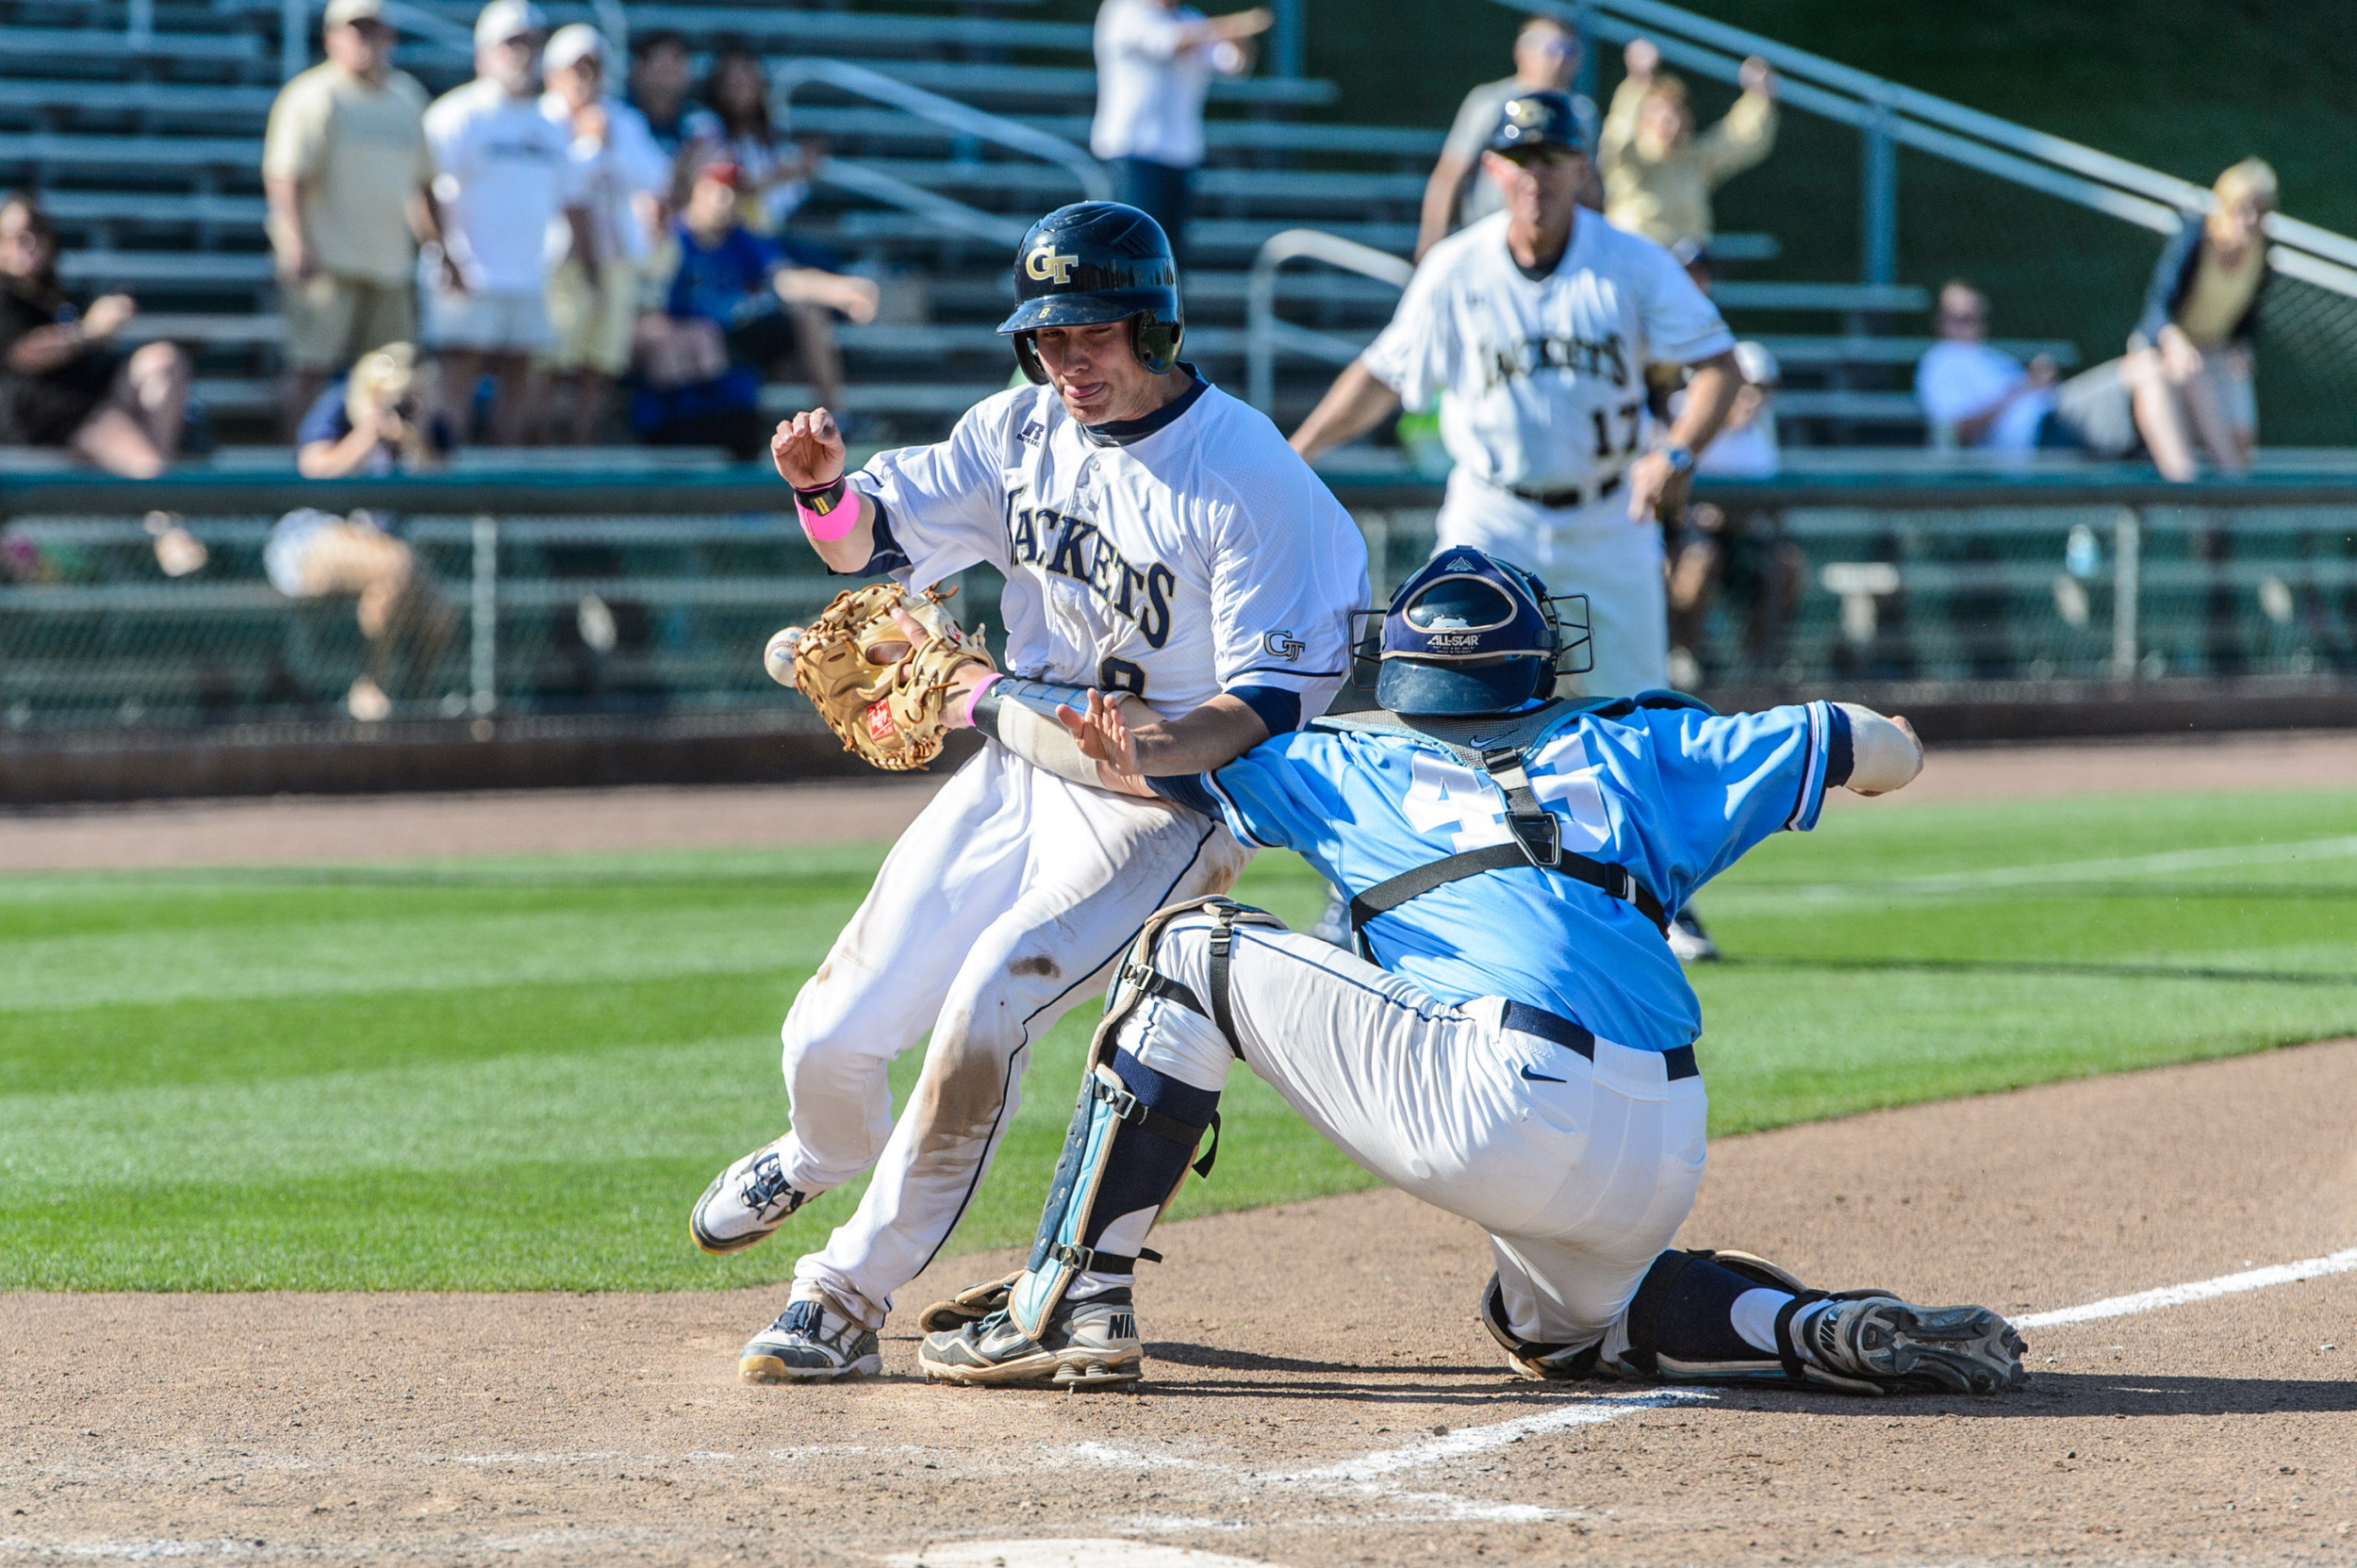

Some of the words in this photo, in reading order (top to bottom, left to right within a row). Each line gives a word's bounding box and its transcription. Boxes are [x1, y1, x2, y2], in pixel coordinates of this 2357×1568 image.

[1026, 244, 1079, 285] GT
[1038, 306, 1051, 320] 8
[1263, 630, 1306, 662] GT
